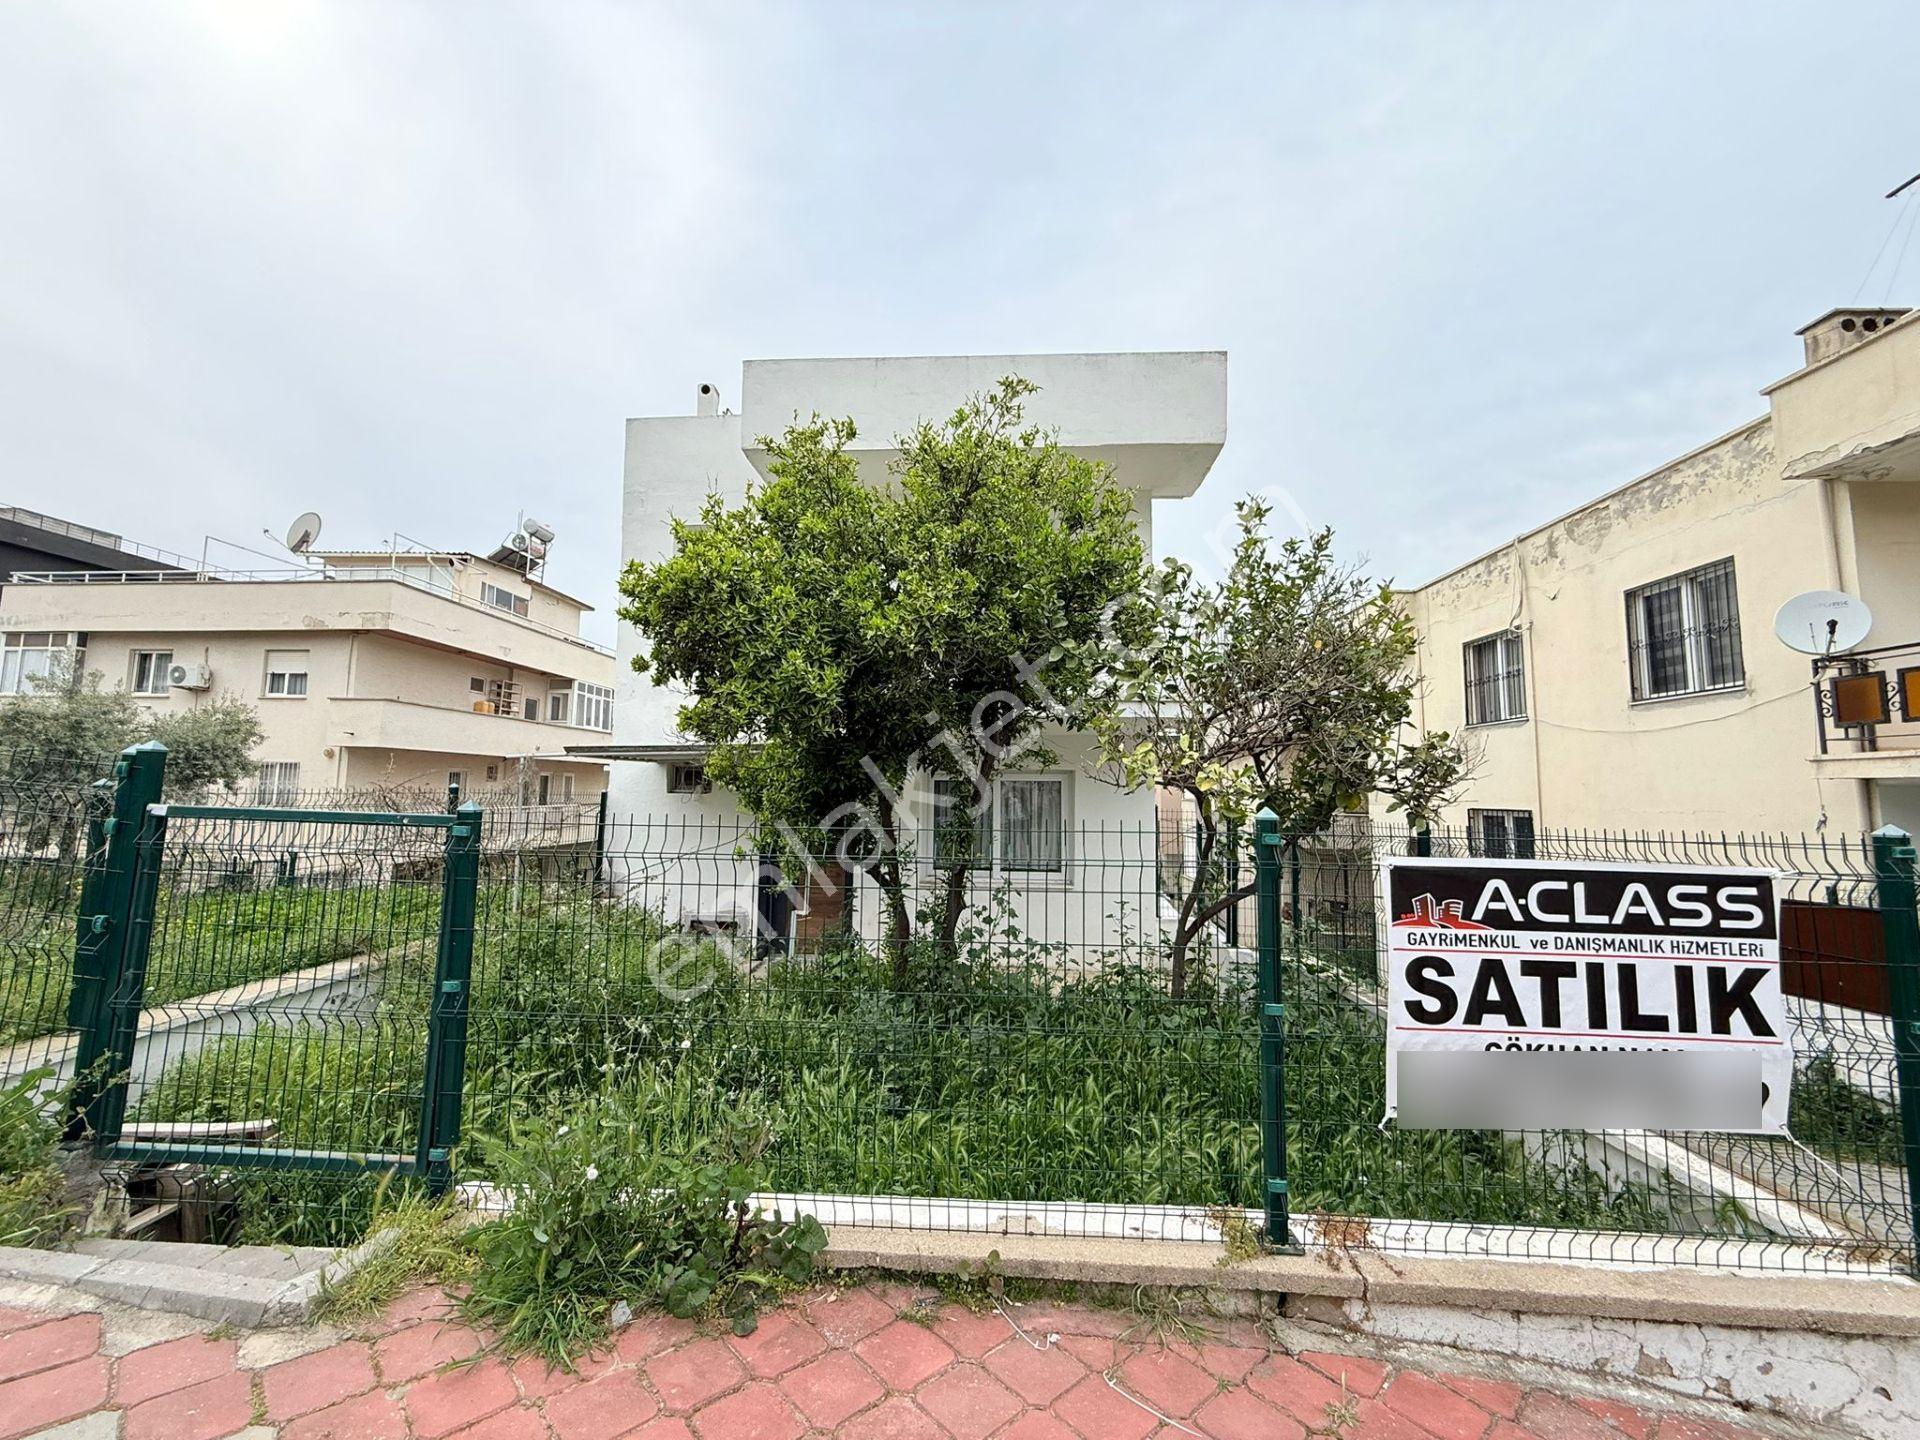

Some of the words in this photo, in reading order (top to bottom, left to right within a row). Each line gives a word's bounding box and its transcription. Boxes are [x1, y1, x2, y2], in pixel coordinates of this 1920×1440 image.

[1530, 940, 1549, 950] ve
[1554, 937, 1665, 955] DANIŞMANLIK
[1404, 955, 1777, 1037] SATILIK
